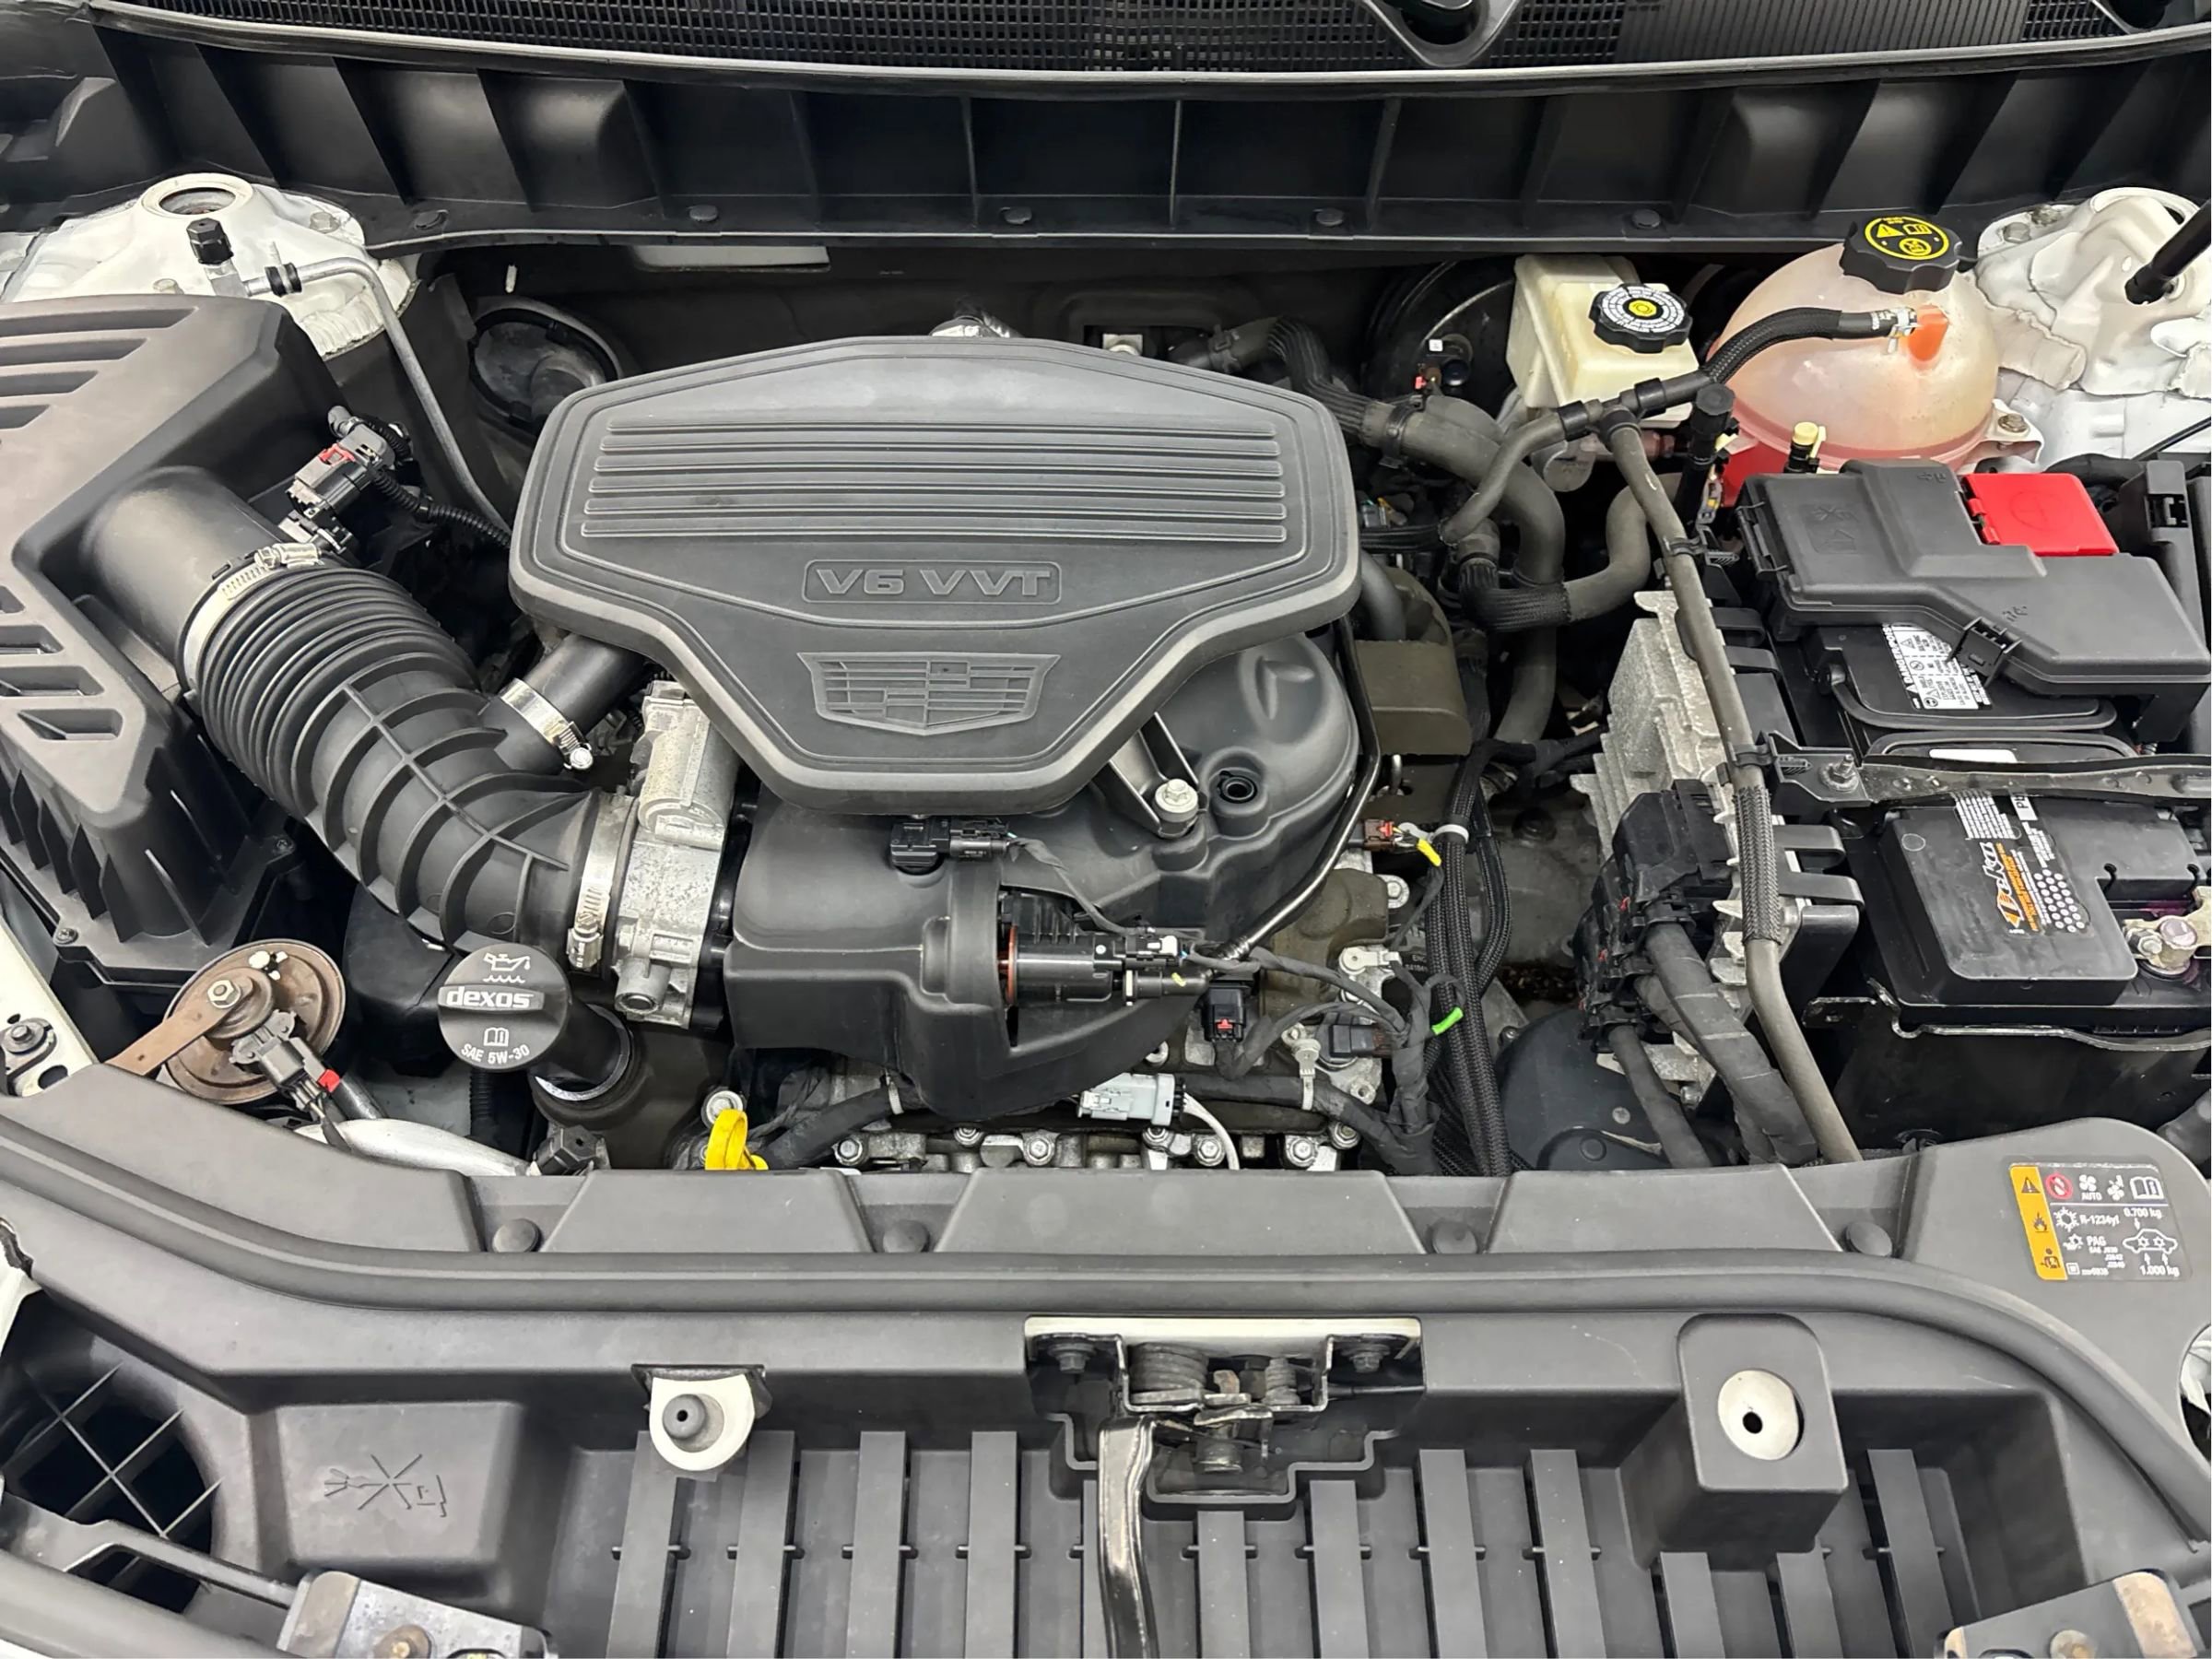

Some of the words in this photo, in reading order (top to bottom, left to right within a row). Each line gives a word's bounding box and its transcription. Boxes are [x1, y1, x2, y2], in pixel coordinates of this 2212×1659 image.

[817, 569, 905, 594] V6
[919, 569, 1051, 595] VVT
[446, 986, 535, 1009] dexos
[461, 1043, 485, 1063] SAE
[488, 1043, 531, 1065] 5W-30
[2081, 1192, 2102, 1201] AUTO
[2123, 1207, 2148, 1218] 0.700
[2148, 1207, 2162, 1219] kg
[2086, 1235, 2106, 1246] PAG
[2139, 1265, 2165, 1276] 1.000
[2167, 1265, 2180, 1277] kg
